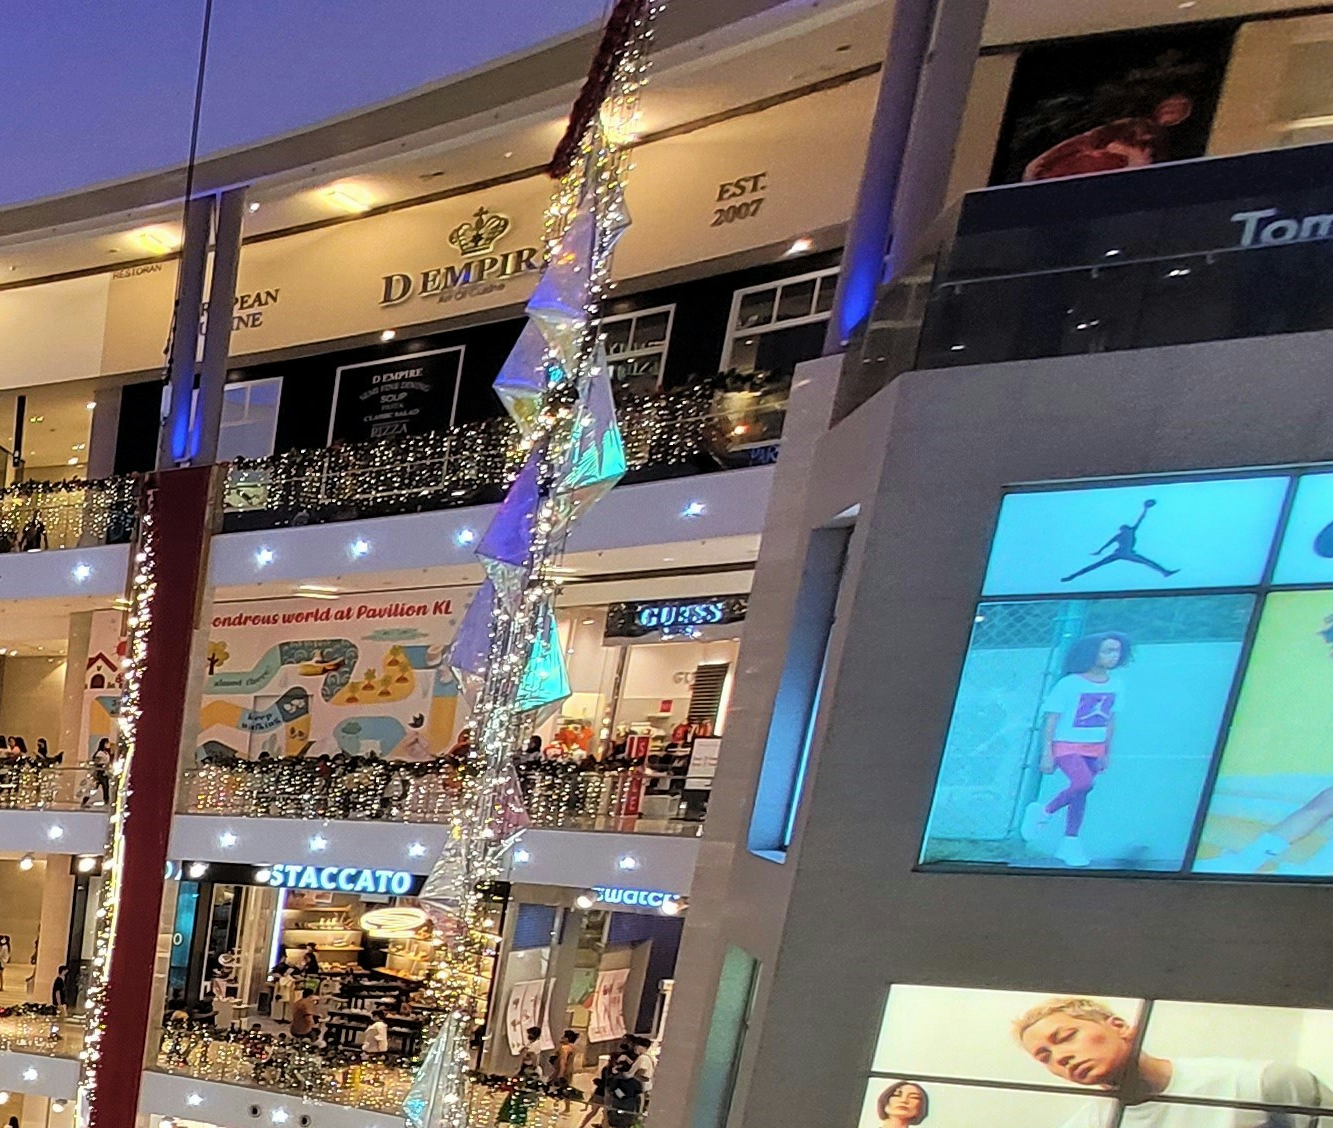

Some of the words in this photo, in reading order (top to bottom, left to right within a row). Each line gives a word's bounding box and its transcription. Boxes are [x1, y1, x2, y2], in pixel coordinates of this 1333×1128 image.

[717, 171, 767, 202] EST.
[710, 197, 765, 227] 2007
[112, 264, 163, 280] RESTORAN
[419, 246, 542, 296] EMPIR
[212, 611, 279, 628] ondrous
[282, 607, 332, 624] world
[333, 605, 353, 621] at
[356, 603, 429, 620] Pavilion
[432, 599, 454, 616] KL
[270, 863, 412, 894] STACCATO
